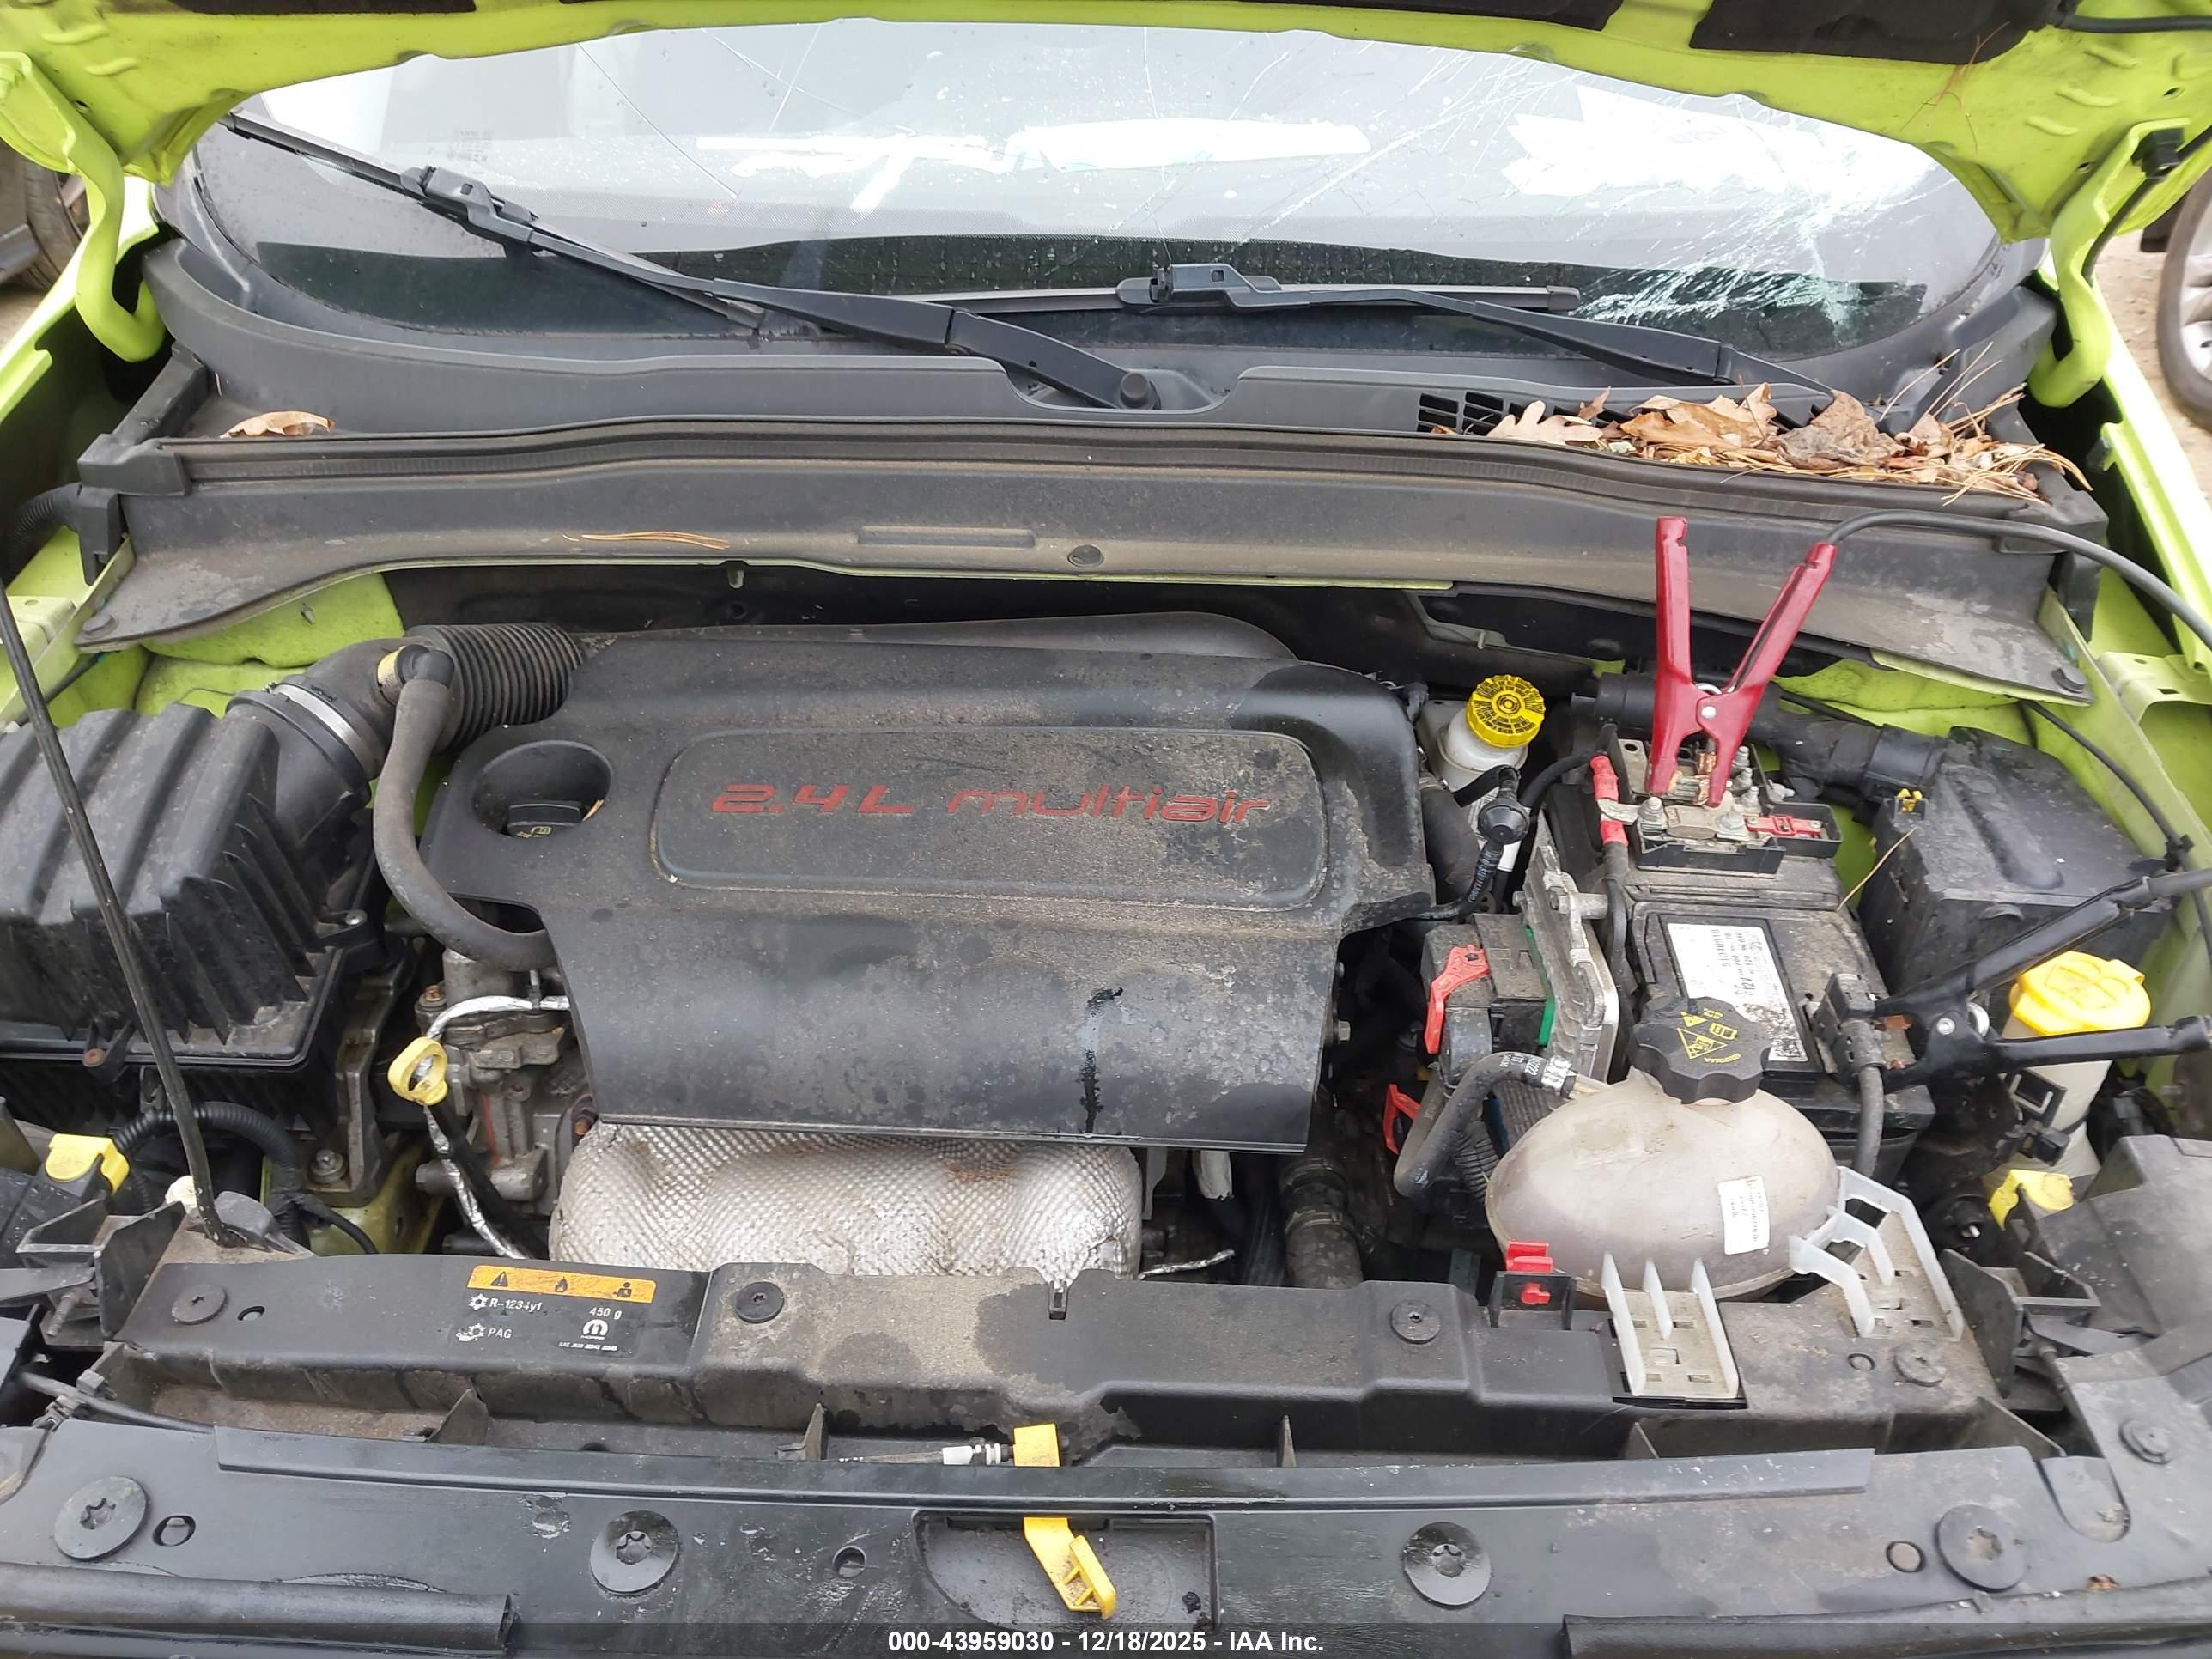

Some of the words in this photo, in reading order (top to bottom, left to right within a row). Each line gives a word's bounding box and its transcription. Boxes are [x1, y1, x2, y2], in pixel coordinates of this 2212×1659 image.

[947, 784, 1270, 823] multiair
[589, 1307, 611, 1317] 450
[614, 1310, 623, 1320] g
[488, 1328, 513, 1339] PAG
